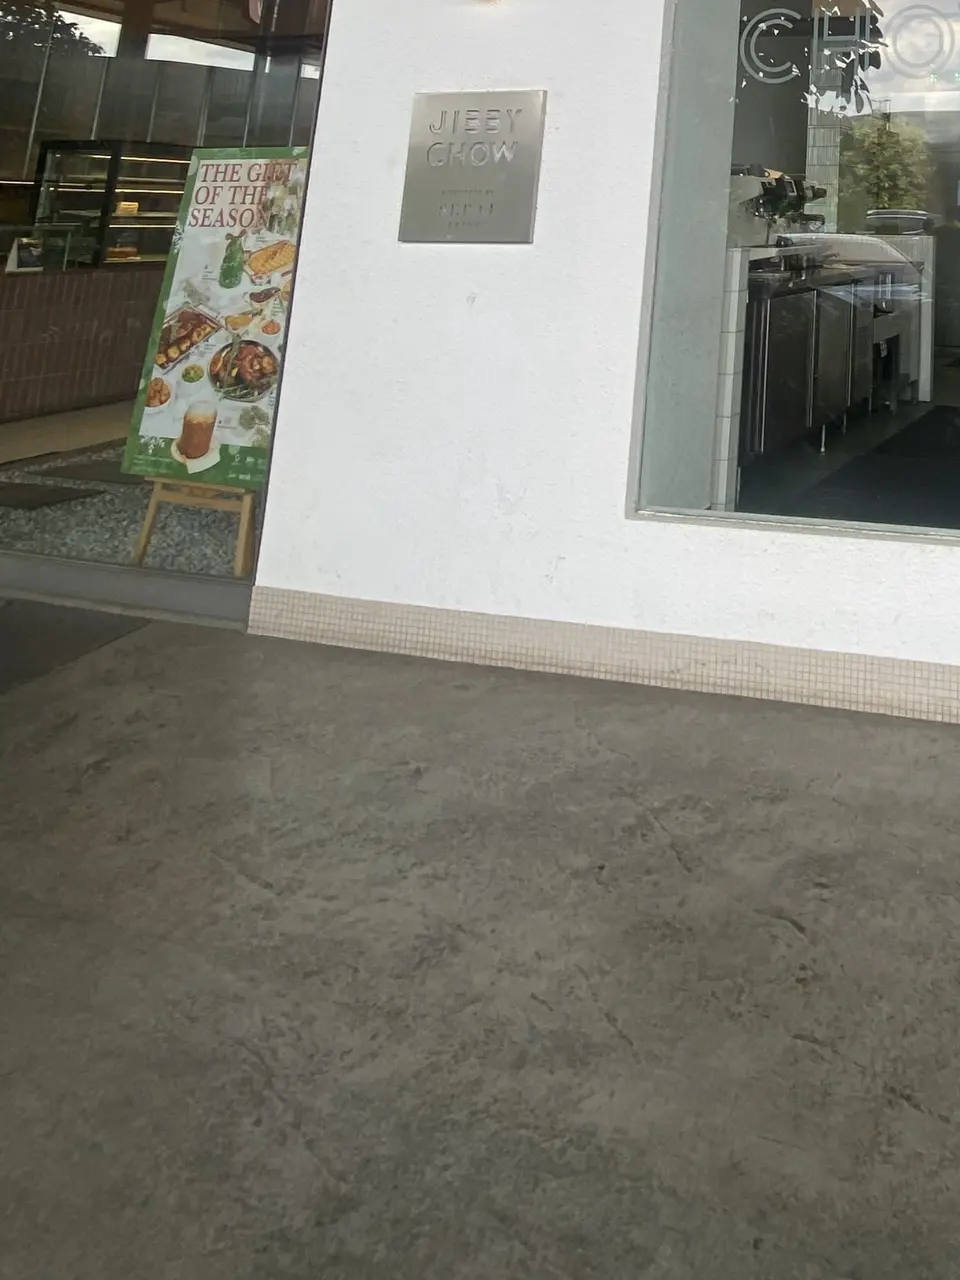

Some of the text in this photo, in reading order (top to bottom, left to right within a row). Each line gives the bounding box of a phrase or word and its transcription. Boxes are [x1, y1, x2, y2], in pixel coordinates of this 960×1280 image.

[428, 108, 523, 136] JIBBY
[426, 140, 519, 167] CHOW
[201, 162, 297, 183] THE GIFT
[195, 185, 223, 204] OF
[188, 207, 268, 228] SEASON
